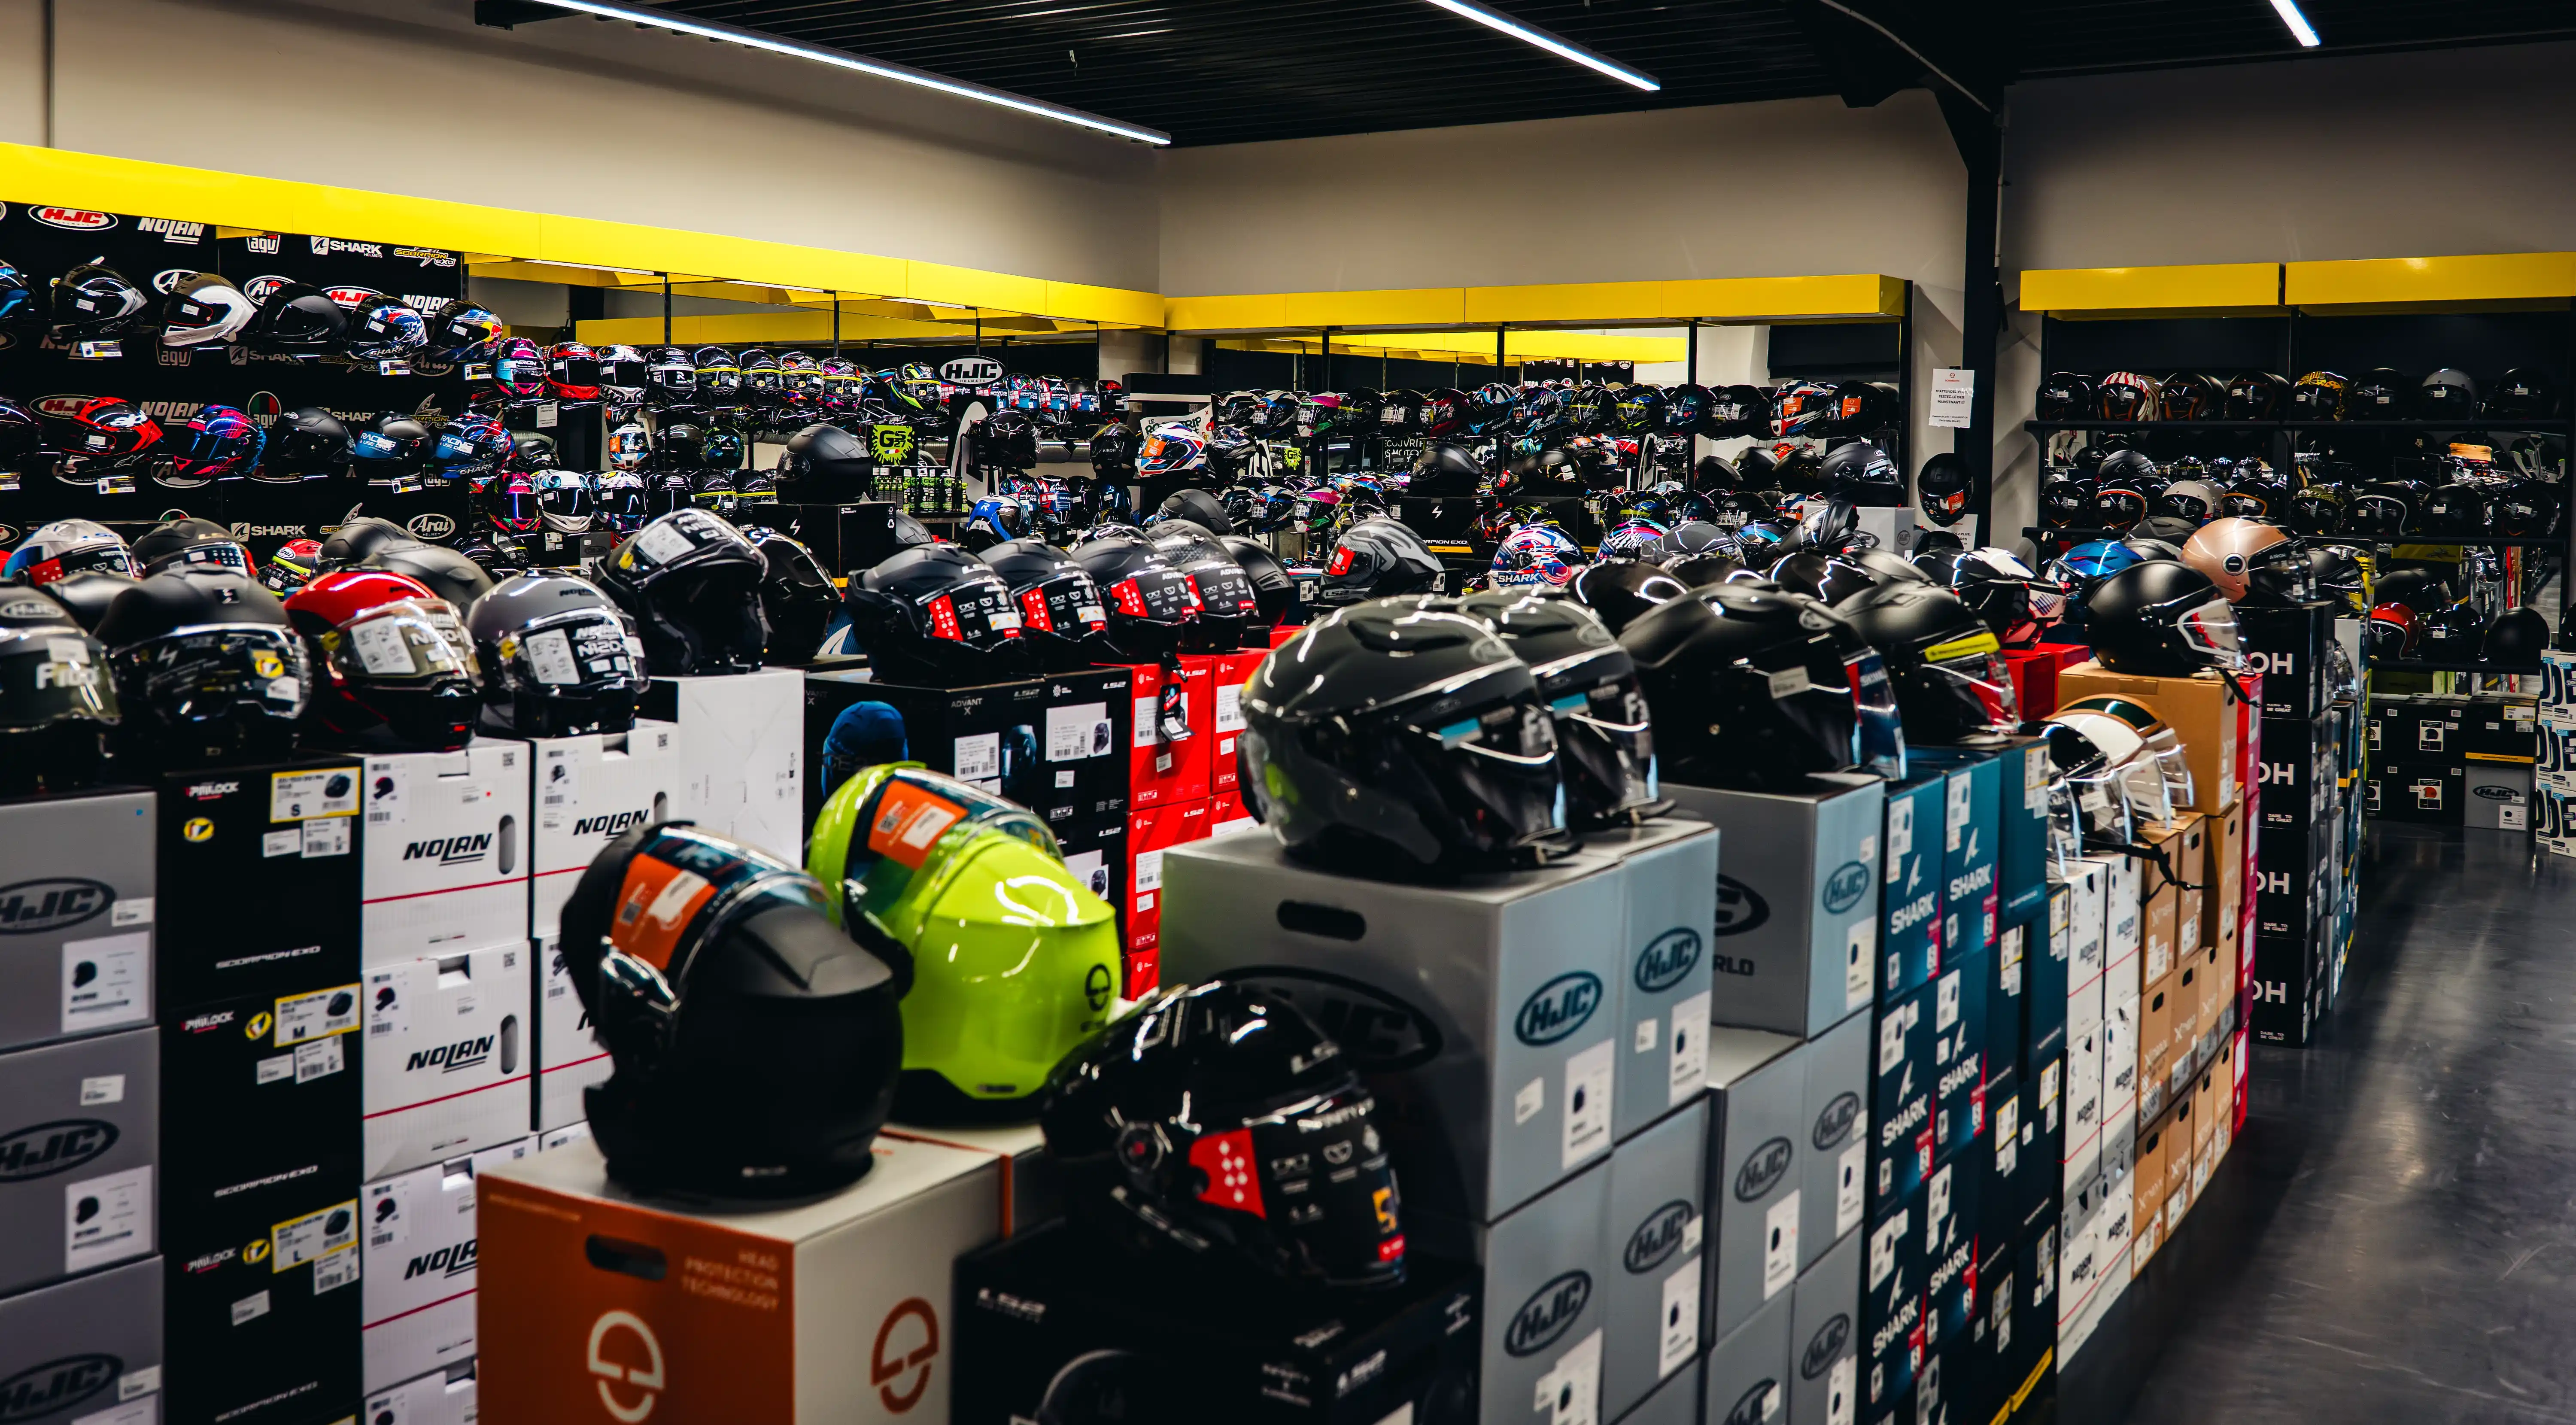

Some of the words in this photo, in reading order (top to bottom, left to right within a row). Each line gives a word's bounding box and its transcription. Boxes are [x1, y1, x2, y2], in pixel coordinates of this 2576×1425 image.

[43, 207, 103, 224] HJC
[137, 217, 204, 244] NOLAN
[251, 238, 275, 253] agv
[330, 240, 382, 255] SHARK
[395, 249, 448, 259] SCORPION
[161, 351, 187, 366] agv
[369, 346, 404, 356] SHARK
[945, 362, 998, 379] HJC
[1535, 419, 1557, 431] SHARK
[879, 429, 906, 448] GS27
[459, 462, 494, 474] SHARK
[251, 525, 306, 535] SHARK
[411, 517, 450, 532] Arai
[279, 548, 293, 557] Arai
[1498, 574, 1539, 583] SHARK
[1014, 689, 1040, 697] LS2
[1102, 681, 1126, 690] LS2
[951, 697, 983, 708] ADVANT
[963, 707, 971, 716] X
[2479, 788, 2513, 798] HJC
[291, 804, 301, 816] S
[1183, 809, 1205, 817] LS2
[574, 809, 649, 837] NOLAN
[1098, 826, 1121, 837] LS2
[403, 833, 493, 866] NOLAN
[1829, 869, 1864, 902] HJC
[1950, 863, 1992, 902] SHARK
[1890, 891, 1935, 935] SHARK
[1644, 938, 1692, 983] HJC
[1528, 982, 1592, 1035] HJC
[293, 1026, 306, 1038] M
[406, 1035, 494, 1074] NOLAN
[1939, 1052, 1979, 1100] SHARK
[1882, 1093, 1929, 1148] SHARK
[1742, 1145, 1785, 1193] HJC
[1635, 1208, 1686, 1265] HJC
[292, 1250, 302, 1261] L
[404, 1239, 478, 1279] NOLA
[1929, 1240, 1971, 1296] SHARK
[1519, 1279, 1581, 1347] HJC
[1872, 1294, 1919, 1358] SHARK
